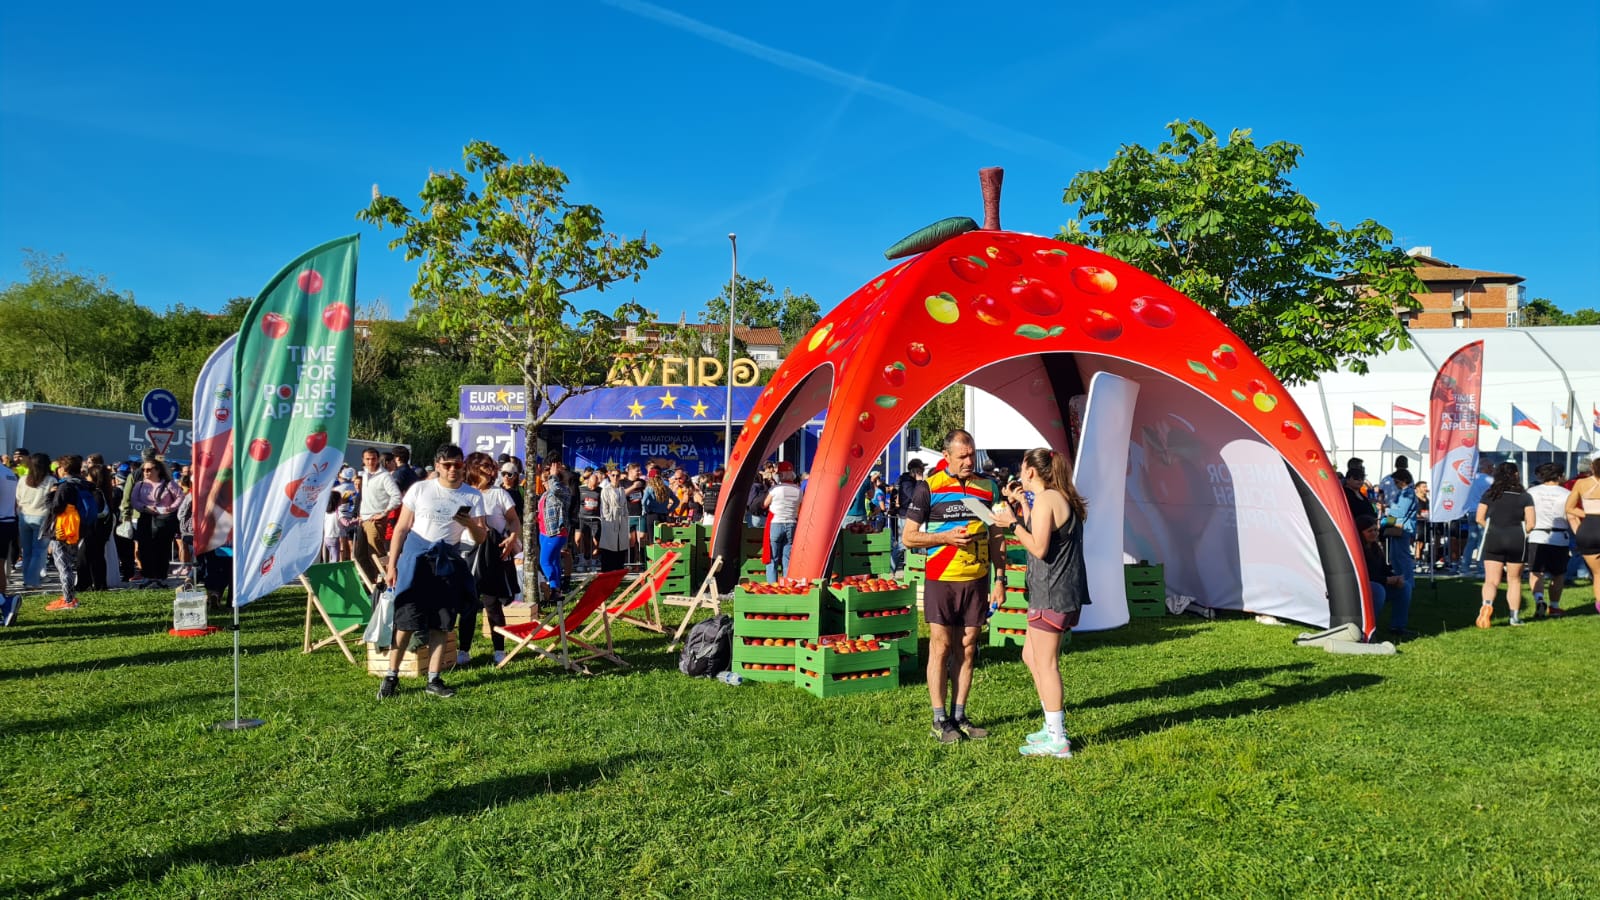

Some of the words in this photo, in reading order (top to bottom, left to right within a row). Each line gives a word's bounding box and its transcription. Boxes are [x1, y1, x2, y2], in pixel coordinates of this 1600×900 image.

[287, 345, 337, 362] TIME
[296, 364, 336, 381] FOR
[263, 383, 336, 401] POLISH
[469, 390, 525, 404] EURPE
[1453, 393, 1476, 402] TIME
[262, 402, 336, 419] APPLES
[1456, 403, 1476, 411] FOR
[1441, 421, 1478, 430] APPLES
[640, 444, 698, 456] EURPA
